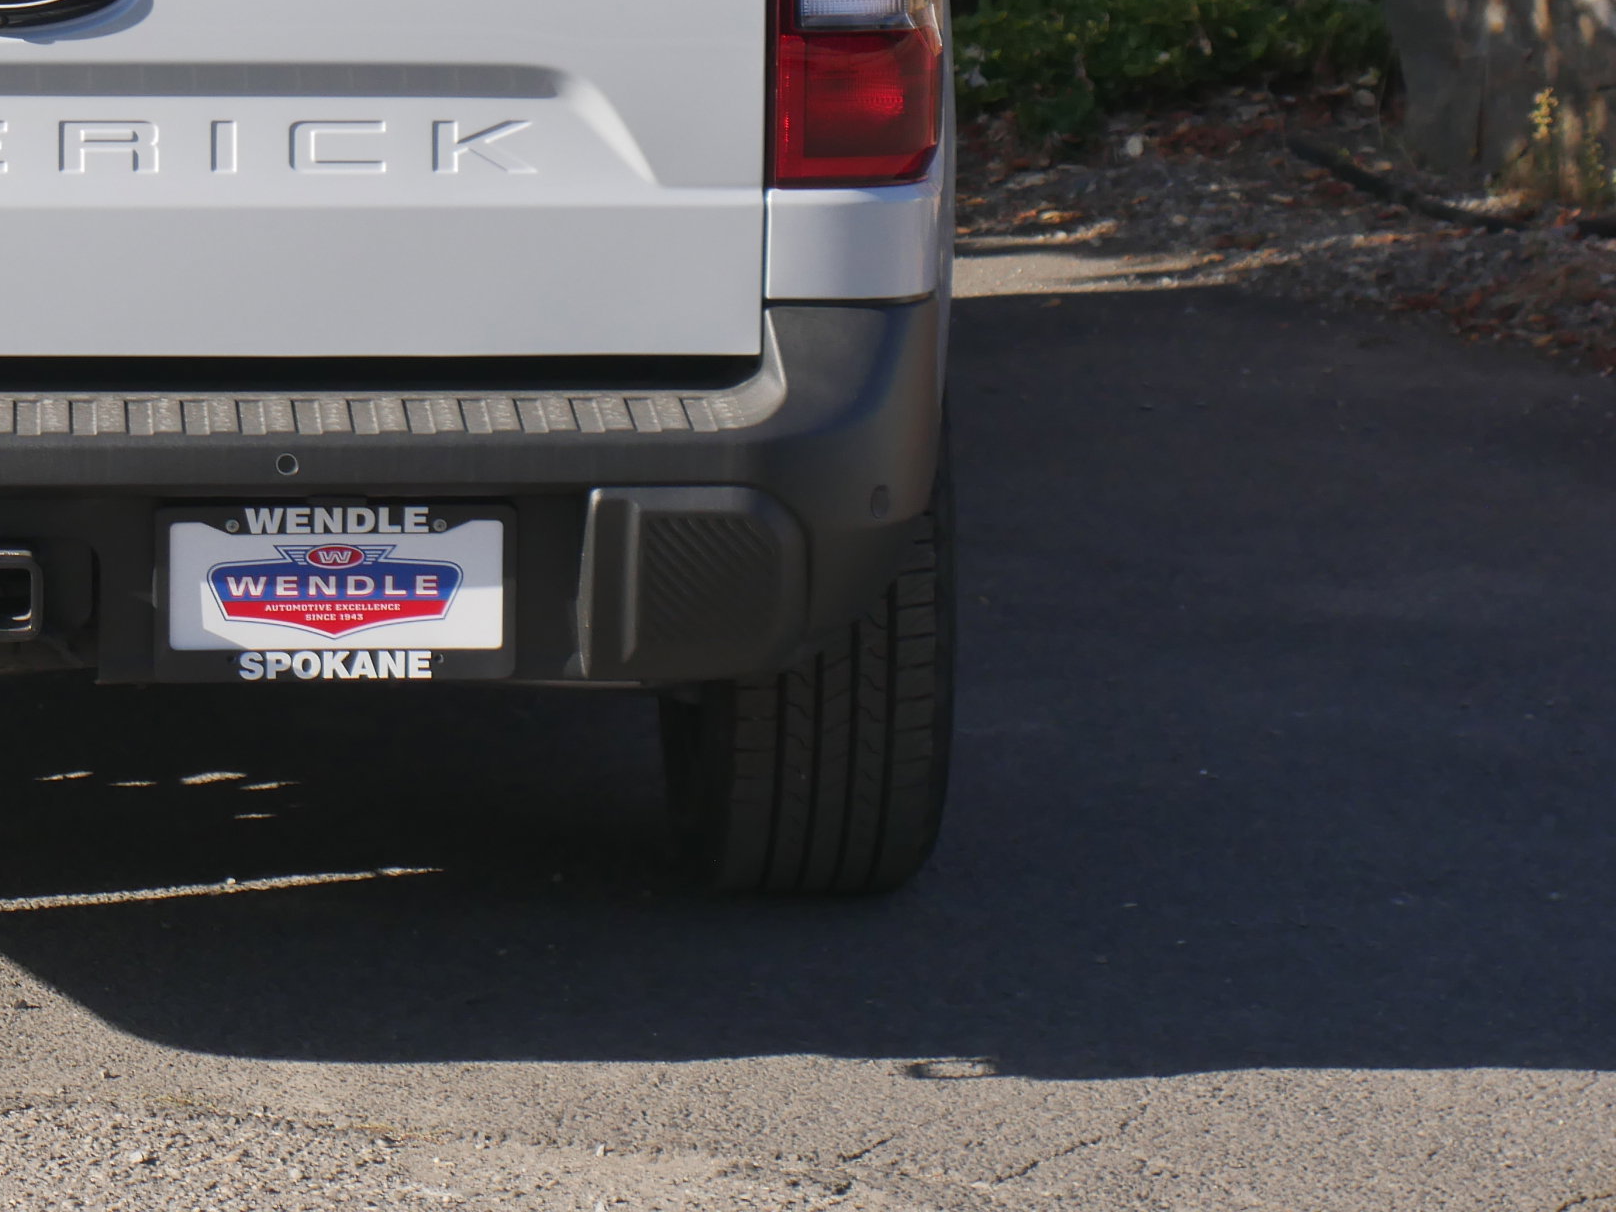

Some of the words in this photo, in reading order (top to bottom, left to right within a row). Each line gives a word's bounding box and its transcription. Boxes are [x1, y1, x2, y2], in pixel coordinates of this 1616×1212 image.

[244, 507, 429, 534] WENDLE
[317, 550, 352, 564] W
[226, 575, 439, 597] WENDLE
[264, 603, 333, 612] AUTOMOTIVE
[335, 603, 401, 612] EXCELLENCE
[304, 613, 338, 622] SINCE
[339, 613, 364, 622] 1943
[238, 650, 433, 681] SPOKANE
